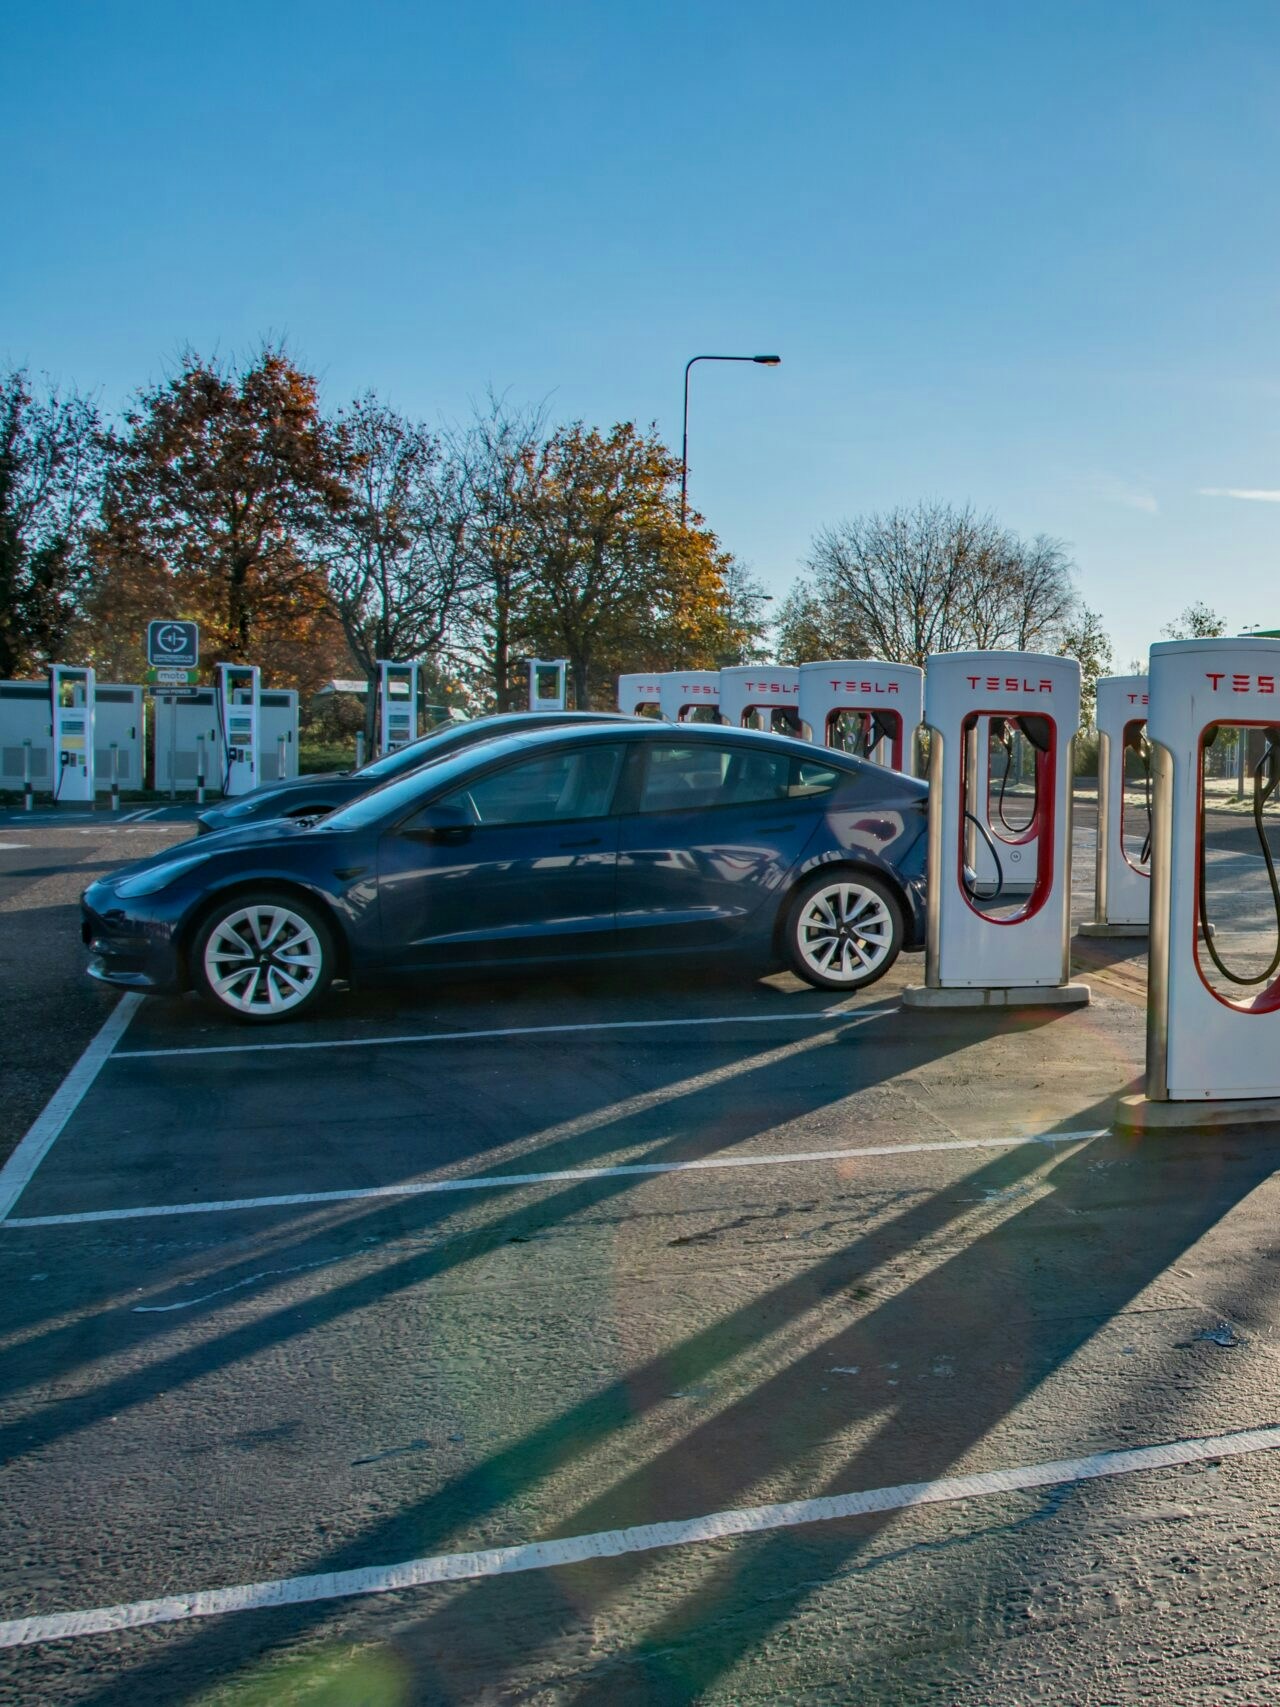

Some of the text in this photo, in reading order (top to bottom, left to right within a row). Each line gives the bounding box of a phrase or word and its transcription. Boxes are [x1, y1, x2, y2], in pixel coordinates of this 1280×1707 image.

[681, 685, 720, 694] TESL
[829, 681, 899, 693] TESLA
[966, 676, 1052, 693] TESLA
